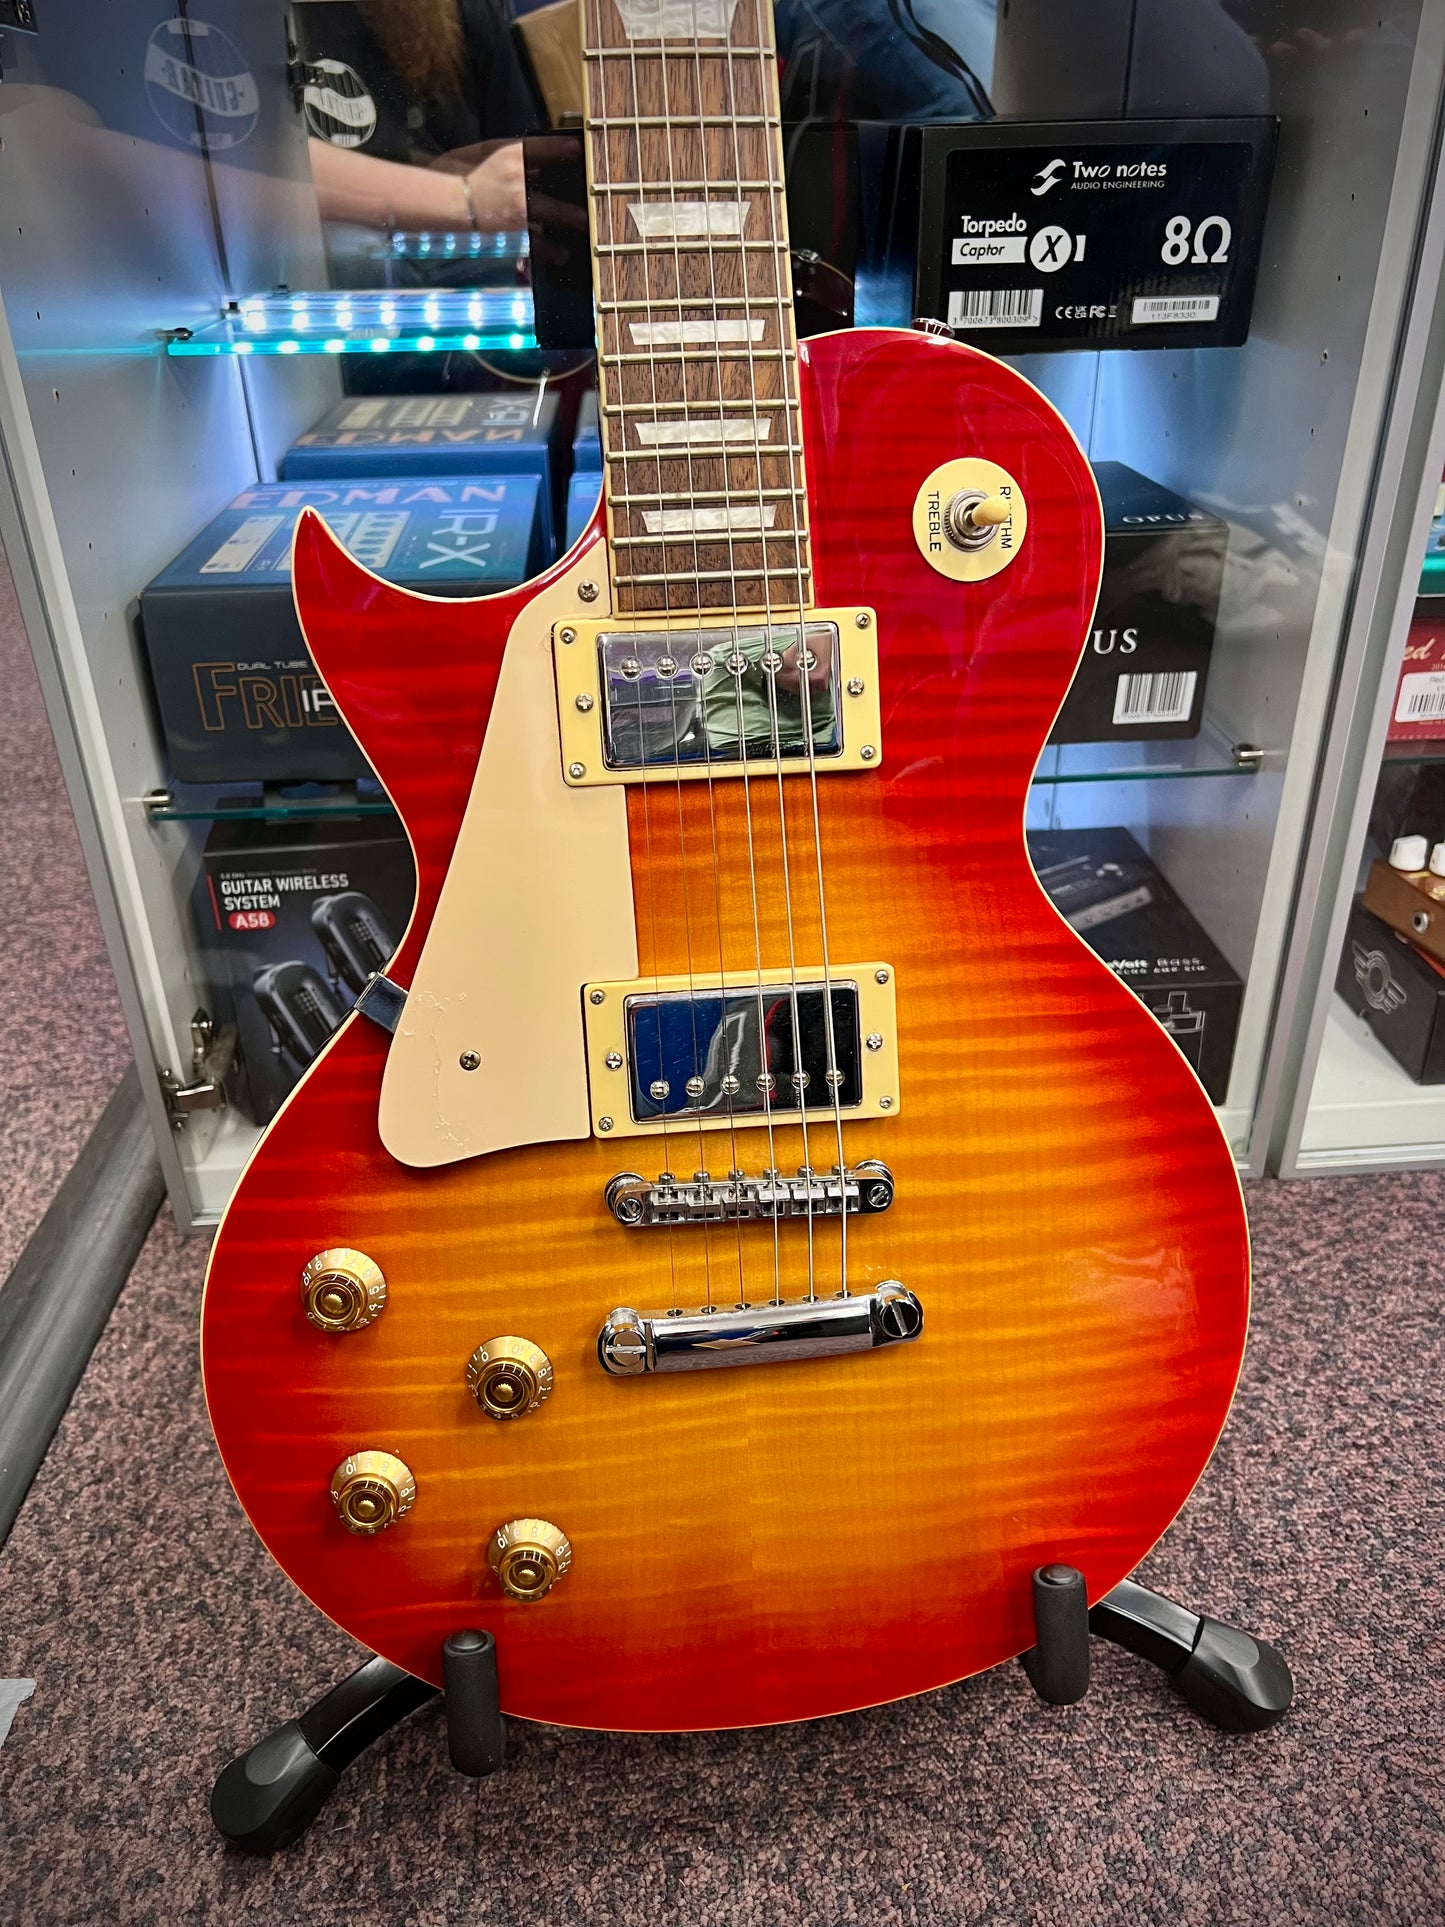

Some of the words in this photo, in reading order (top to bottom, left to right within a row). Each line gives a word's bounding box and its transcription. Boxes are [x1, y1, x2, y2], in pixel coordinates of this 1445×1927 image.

[1072, 161, 1110, 177] Two
[1117, 162, 1167, 176] notes
[1071, 181, 1100, 189] AUDIO
[1103, 180, 1165, 189] ENGINEERING
[961, 212, 1027, 237] Torpedo
[960, 243, 1005, 260] Captor
[1039, 235, 1064, 263] X
[928, 491, 942, 552] TREBLE
[1000, 486, 1013, 549] RTHM
[1122, 513, 1204, 524] OPUS
[419, 508, 500, 569] IR-X
[237, 661, 272, 671] DUAL
[274, 660, 308, 669] TUBE
[221, 879, 273, 895] GUITAR
[276, 873, 349, 891] WIRELESS
[224, 894, 280, 910] SYSTEM
